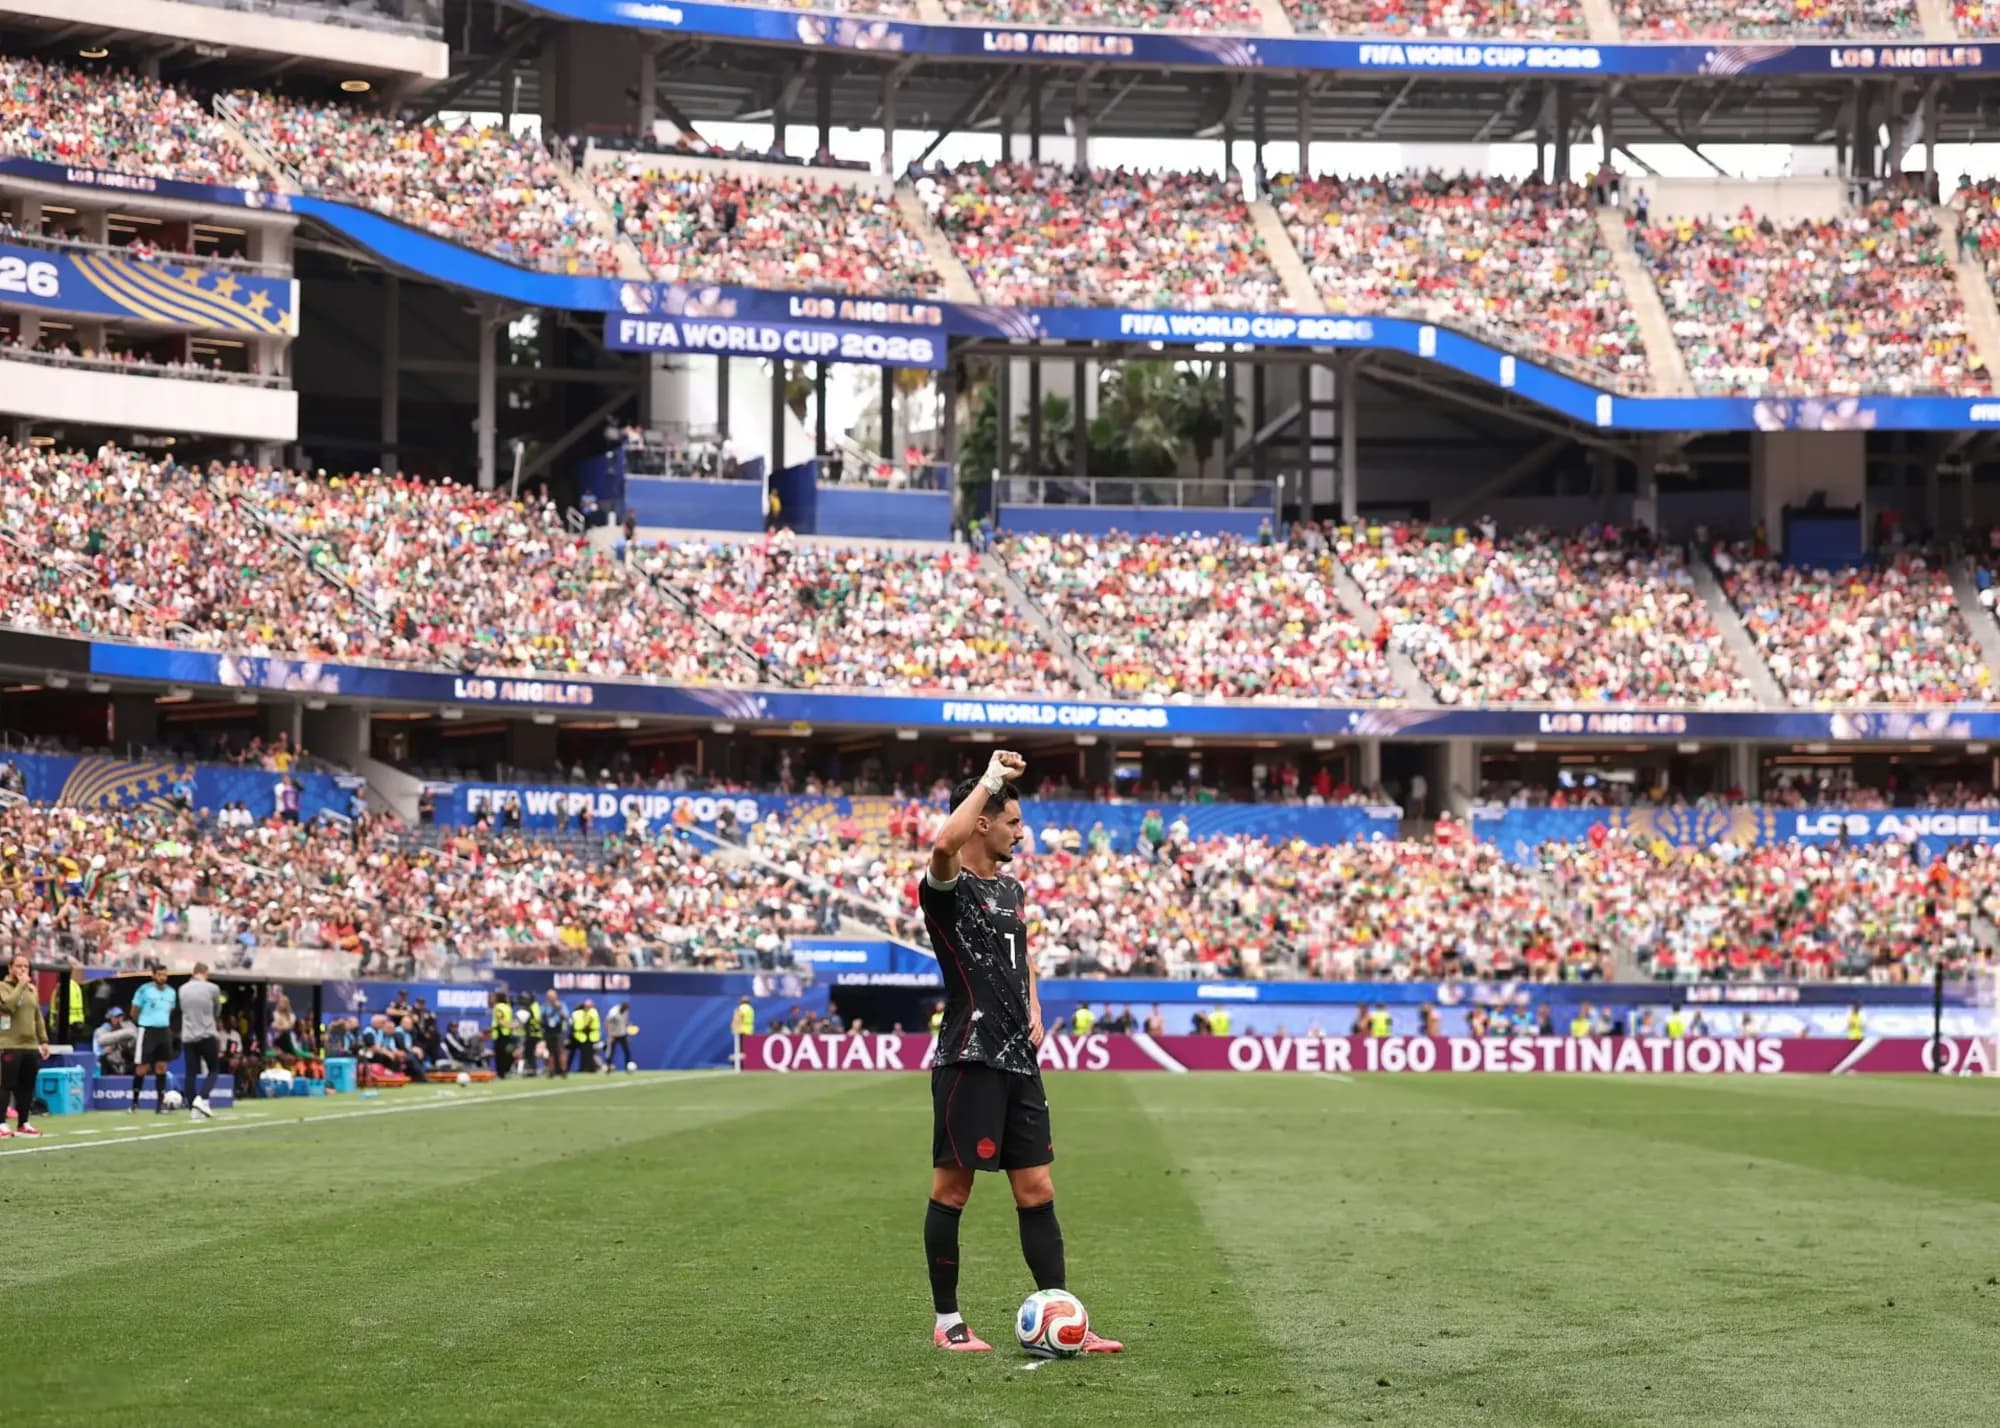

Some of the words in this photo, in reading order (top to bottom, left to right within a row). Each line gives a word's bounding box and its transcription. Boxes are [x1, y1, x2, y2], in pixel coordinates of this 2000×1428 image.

[983, 31, 1028, 52] LOS
[1032, 33, 1134, 56] ANGELES
[1359, 44, 1406, 65] FIFA
[1407, 45, 1482, 66] WORLD
[1482, 47, 1526, 67] CUP
[1526, 48, 1601, 68] 2026
[1830, 48, 1875, 68] LOS
[1879, 48, 1982, 68] ANGELES
[67, 168, 94, 184] LOS
[96, 171, 156, 191] ANGELES
[0, 256, 59, 298] 26
[790, 296, 835, 319] LOS
[839, 300, 942, 326] ANGELES
[619, 319, 680, 348] FIFA
[681, 323, 782, 352] WORLD
[783, 330, 839, 356] CUP
[840, 333, 934, 363] 2026
[1120, 314, 1170, 335] FIFA
[1170, 315, 1250, 338] WORLD
[1251, 317, 1297, 339] CUP
[1297, 319, 1373, 341] 2026
[454, 678, 497, 699] LOS
[501, 681, 594, 704] ANGELES
[942, 701, 986, 722] FIFA
[986, 703, 1056, 724] WORLD
[1058, 705, 1097, 726] CUP
[1097, 707, 1168, 728] 2026
[1540, 713, 1584, 733] LOS
[1587, 713, 1687, 734] ANGELES
[525, 790, 618, 818] WORLD
[620, 794, 671, 819] CUP
[1796, 814, 1871, 836] LOS
[1876, 814, 2000, 836] ANGEL
[1004, 933, 1016, 969] 7
[762, 1034, 902, 1071] QATAR
[919, 1034, 1110, 1071] AAYS
[1228, 1036, 1351, 1073] OVER
[1364, 1036, 1436, 1073] 160
[1450, 1036, 1785, 1073] DESTINATIONS
